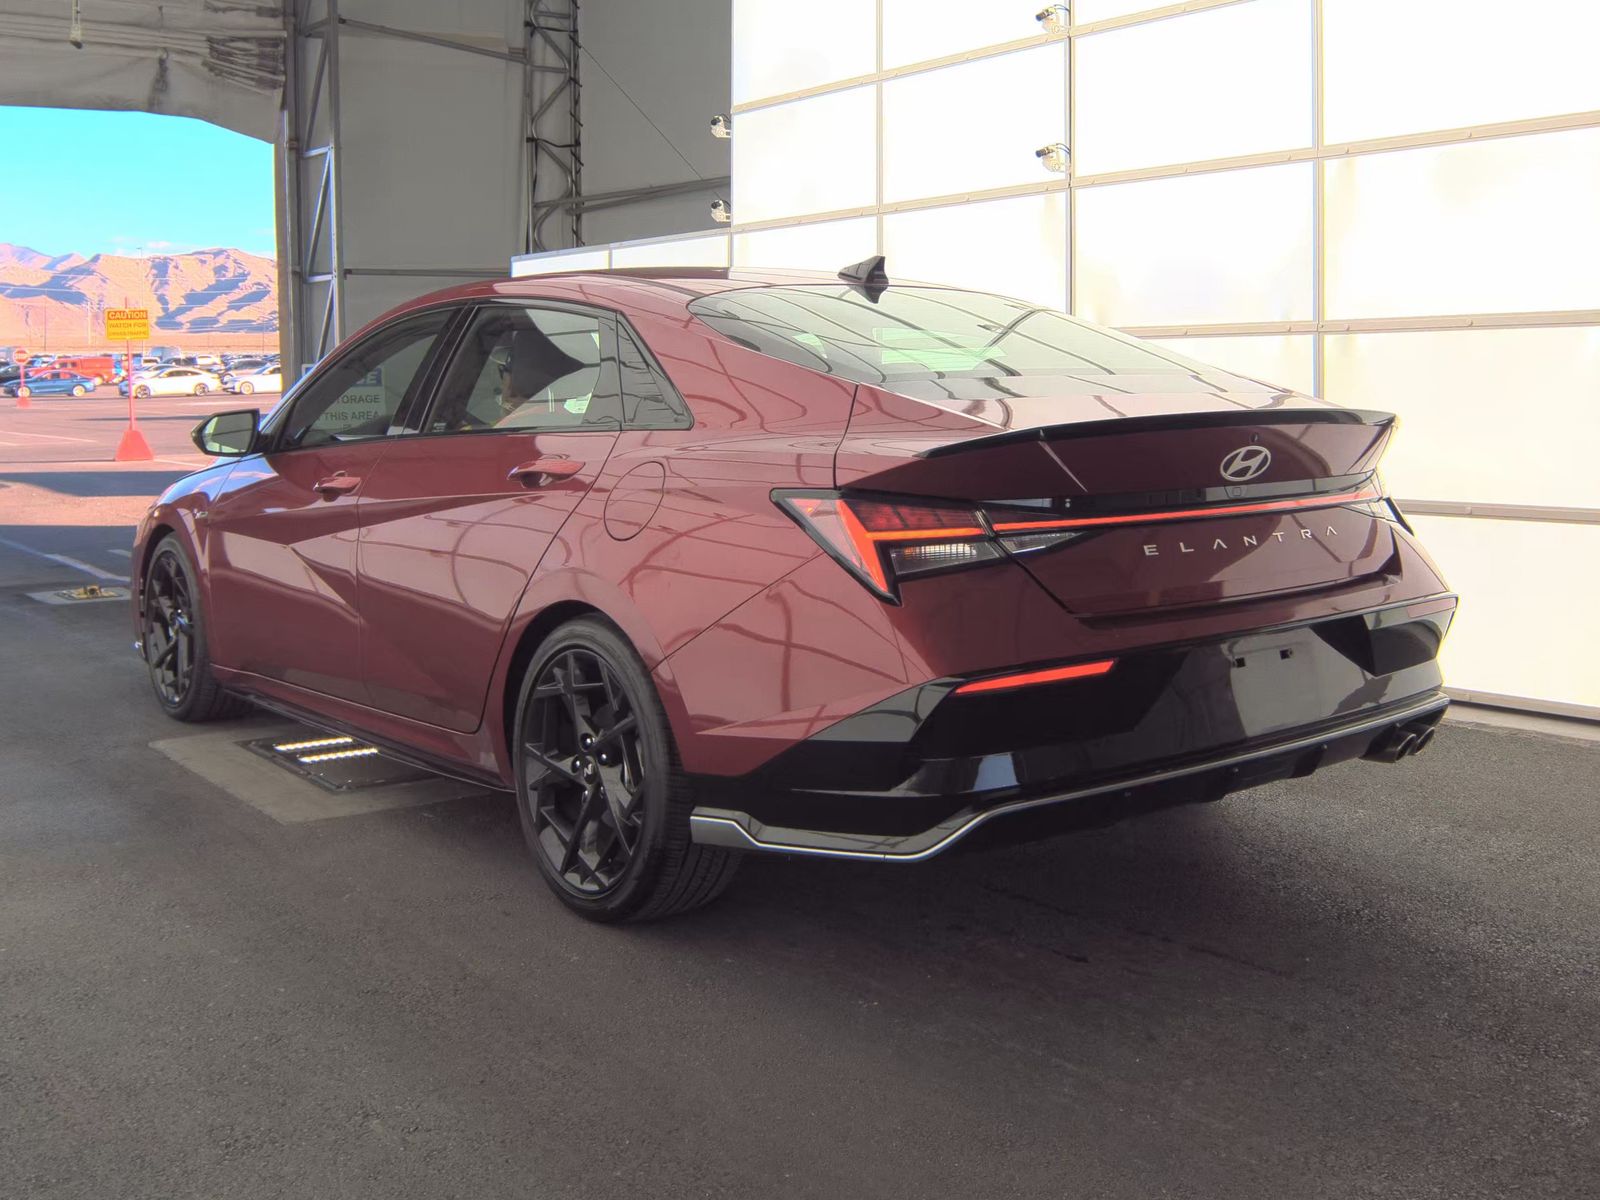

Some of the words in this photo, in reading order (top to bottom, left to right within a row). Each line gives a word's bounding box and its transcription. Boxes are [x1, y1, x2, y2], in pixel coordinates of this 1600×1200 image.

[108, 311, 147, 320] CAUTION
[337, 394, 380, 404] ORAGE
[1143, 525, 1338, 556] ELANTRA
